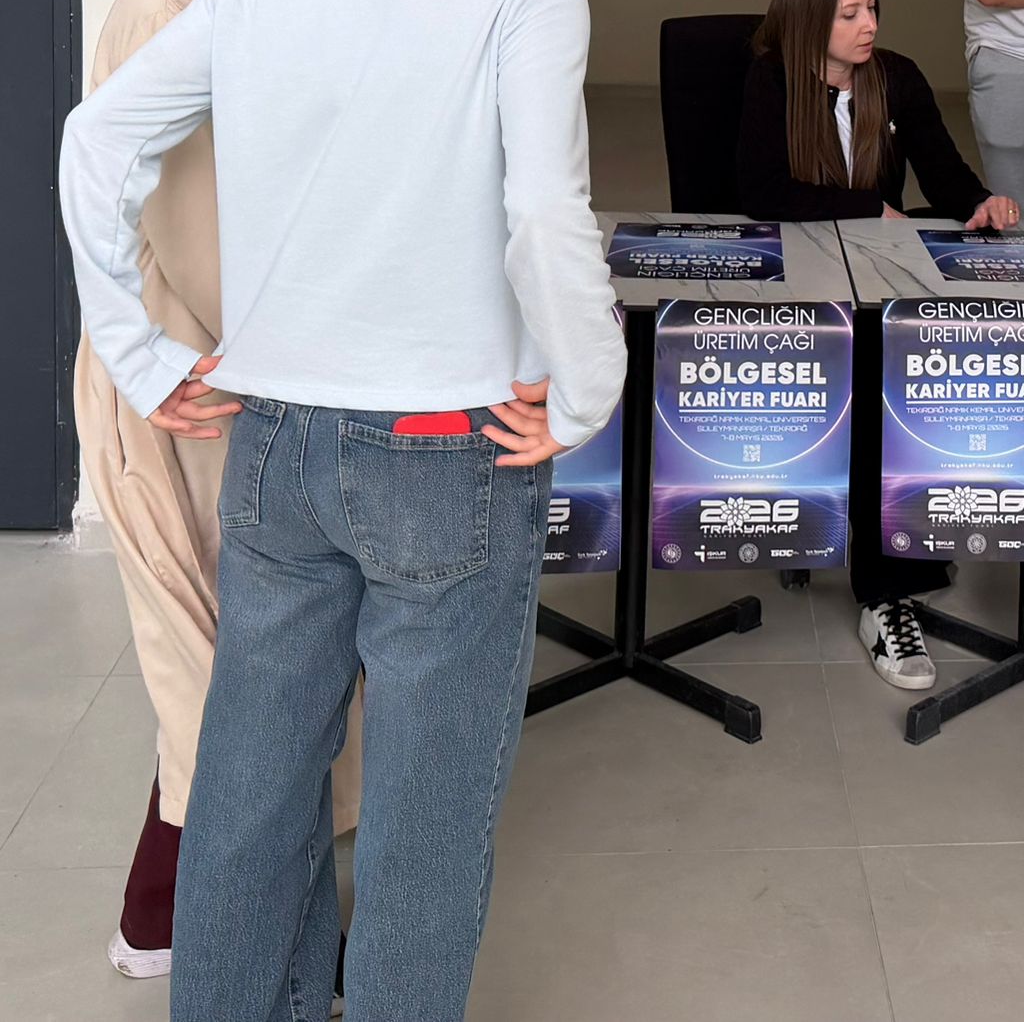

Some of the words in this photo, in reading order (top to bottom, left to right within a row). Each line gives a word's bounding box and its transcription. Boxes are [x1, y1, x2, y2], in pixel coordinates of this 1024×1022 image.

[694, 305, 815, 330] GENÇLİĞİN
[694, 330, 758, 350] ÜRETİM
[763, 330, 814, 354] ÇAĞI
[919, 323, 983, 343] ÜRETİM
[680, 356, 827, 384] BÖLGESEL
[679, 386, 765, 407] KARİYER
[770, 391, 827, 407] FUARI
[906, 379, 990, 399] KARİYER
[700, 524, 799, 534] TRAKYAKAF
